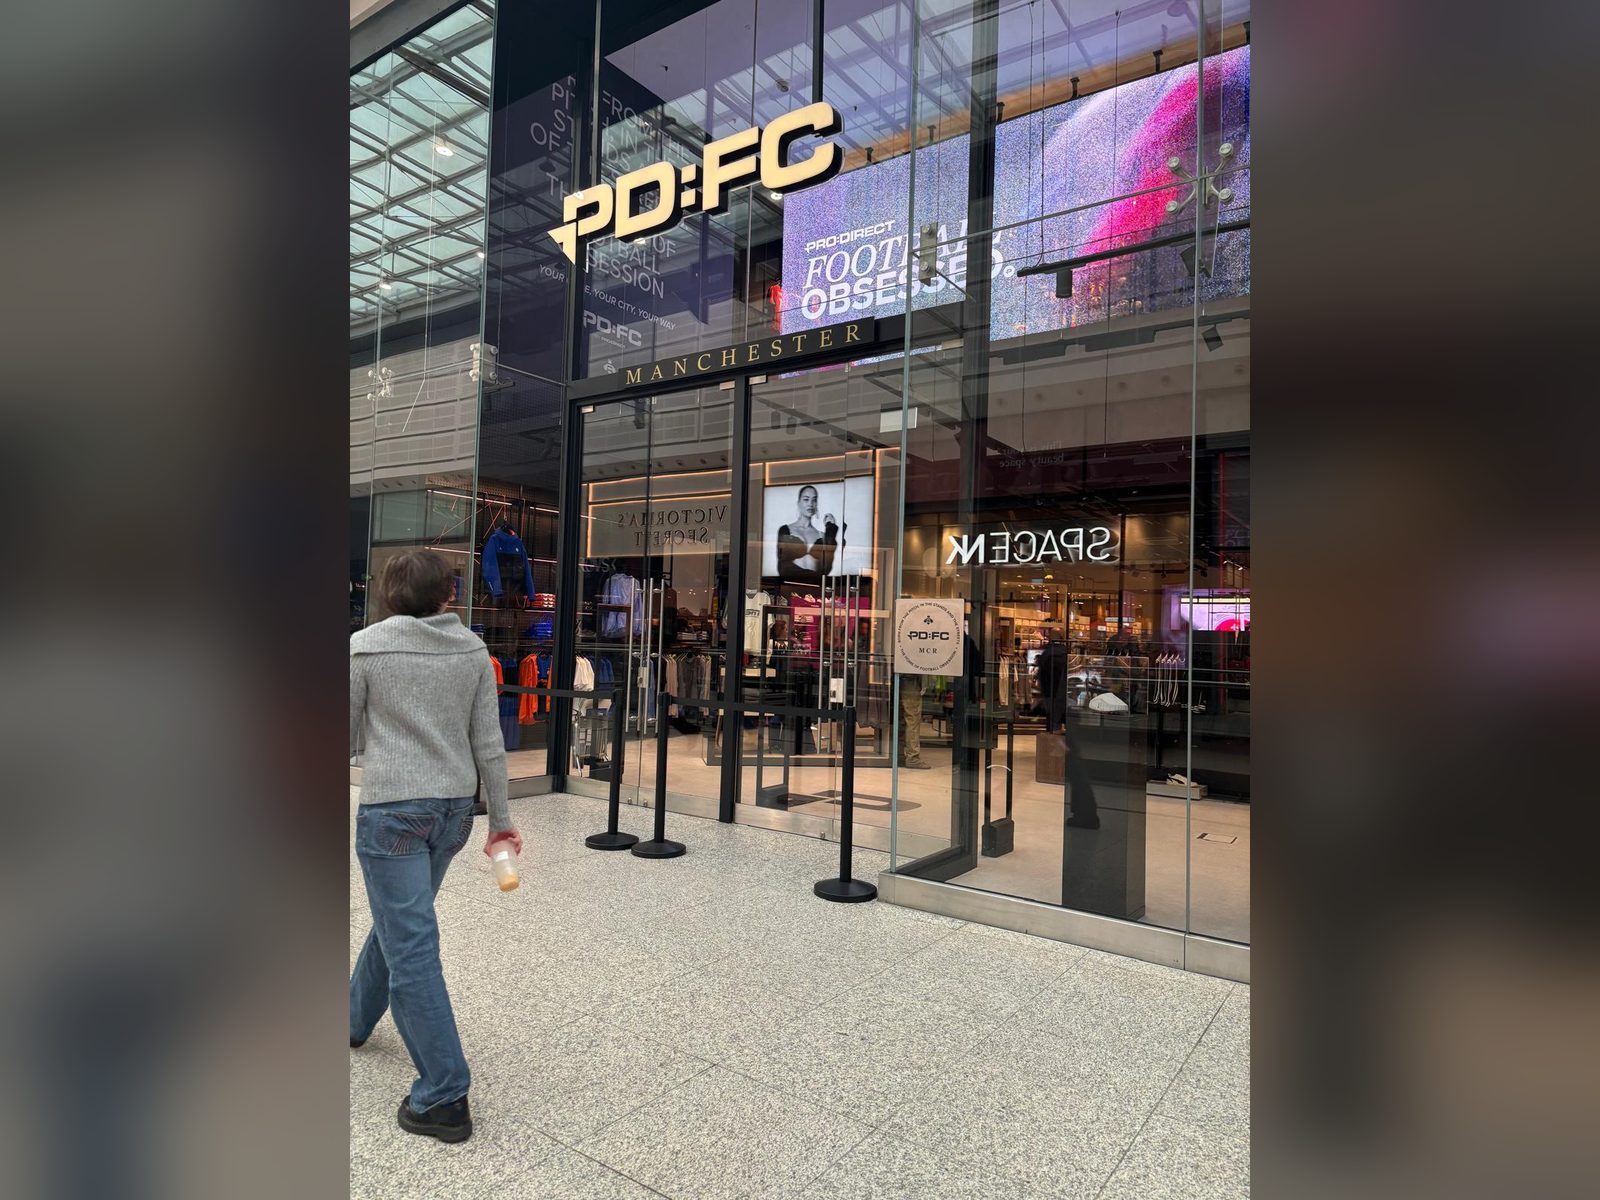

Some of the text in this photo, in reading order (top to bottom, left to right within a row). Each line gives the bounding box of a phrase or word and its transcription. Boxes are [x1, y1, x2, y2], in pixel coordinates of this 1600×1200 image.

[547, 101, 842, 265] PD:FC
[539, 264, 565, 283] YOUR
[594, 289, 618, 306] YOUR
[618, 300, 637, 315] CITY,
[638, 308, 659, 324] YOUR
[659, 318, 677, 331] WAY
[583, 309, 642, 347] PD:FC
[626, 324, 861, 385] MANCHESTER
[907, 631, 950, 641] PD:FC
